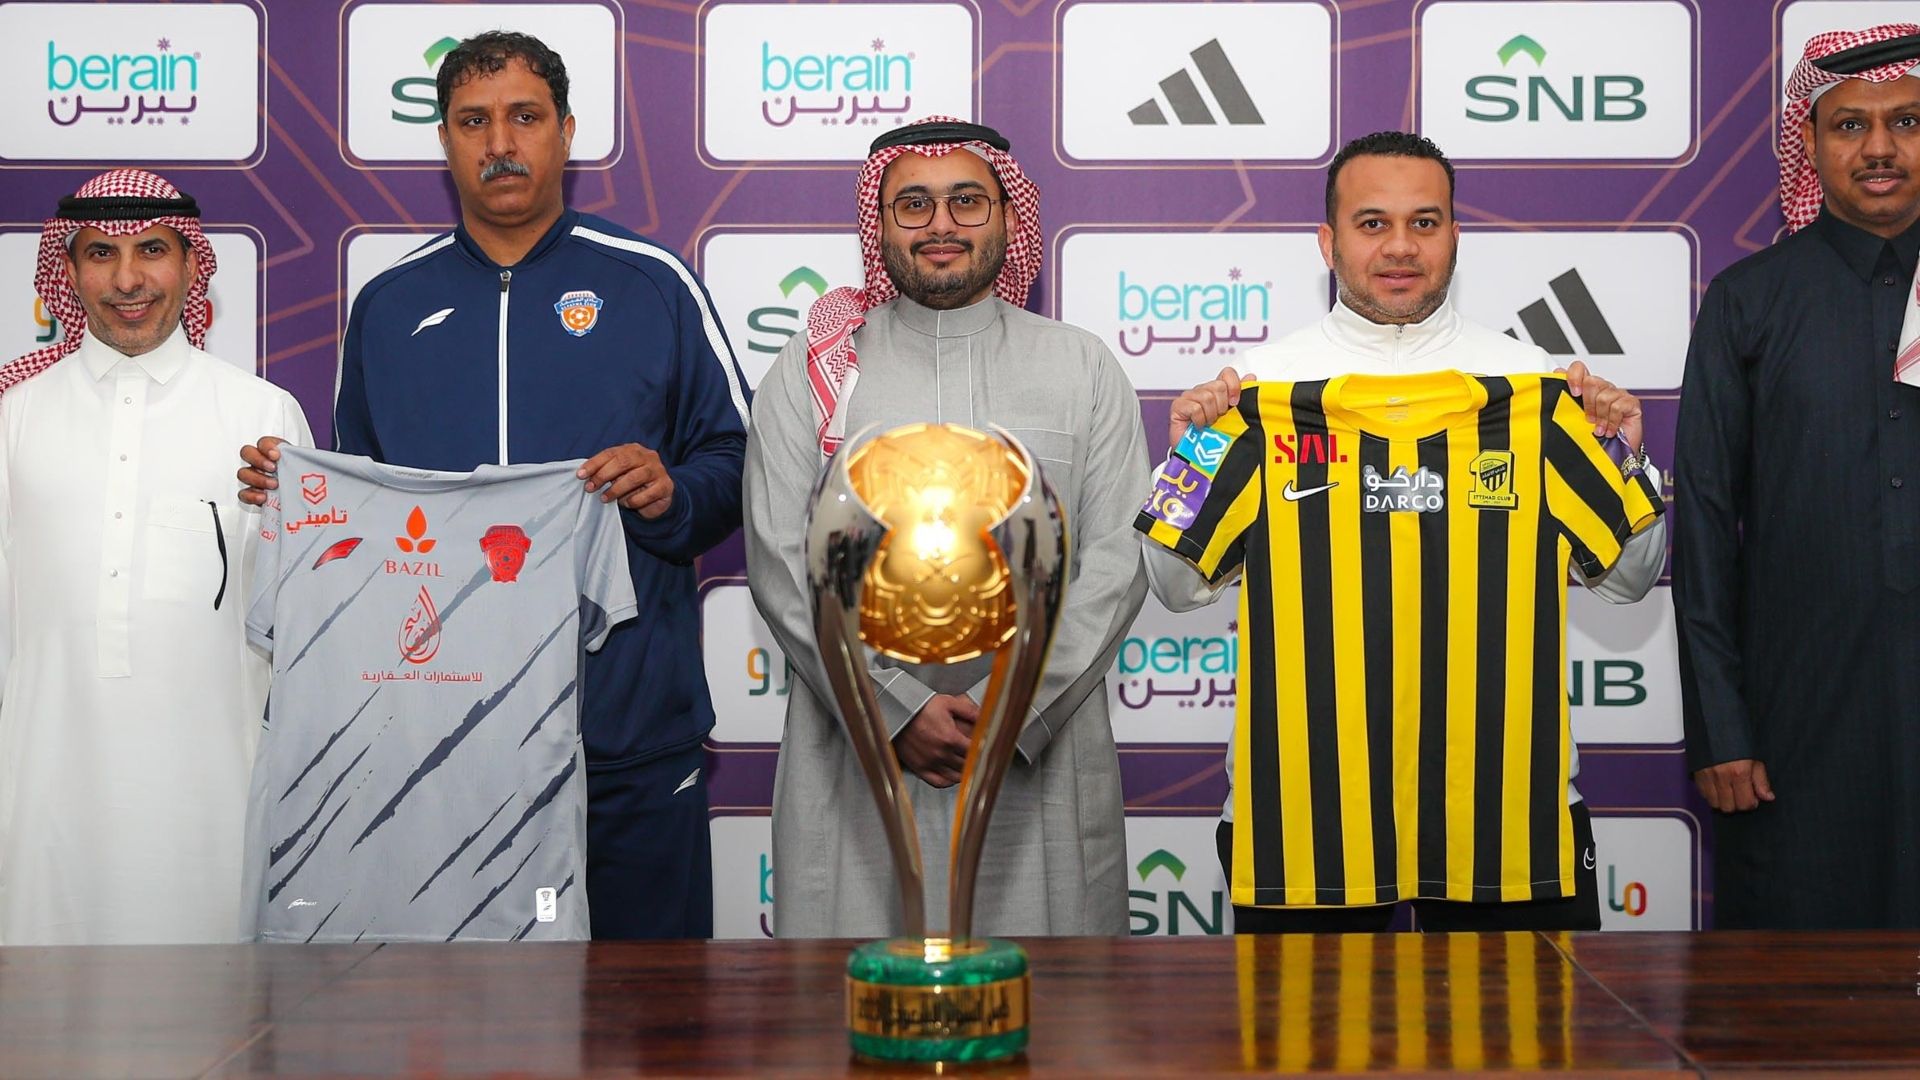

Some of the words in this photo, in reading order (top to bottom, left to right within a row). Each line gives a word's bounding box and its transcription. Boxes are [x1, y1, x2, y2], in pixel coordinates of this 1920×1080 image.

[48, 38, 198, 91] berain
[762, 38, 912, 92] berain
[47, 95, 197, 126] بيرين
[762, 95, 911, 127] بيرين
[1465, 75, 1647, 122] SNB
[1119, 267, 1271, 321] berain
[1274, 434, 1348, 464] SAL
[1366, 468, 1441, 491] داركو
[1366, 495, 1441, 509] DARCO
[386, 560, 445, 577] BAZIL
[1119, 620, 1238, 674] berai
[1129, 890, 1224, 936] SN
